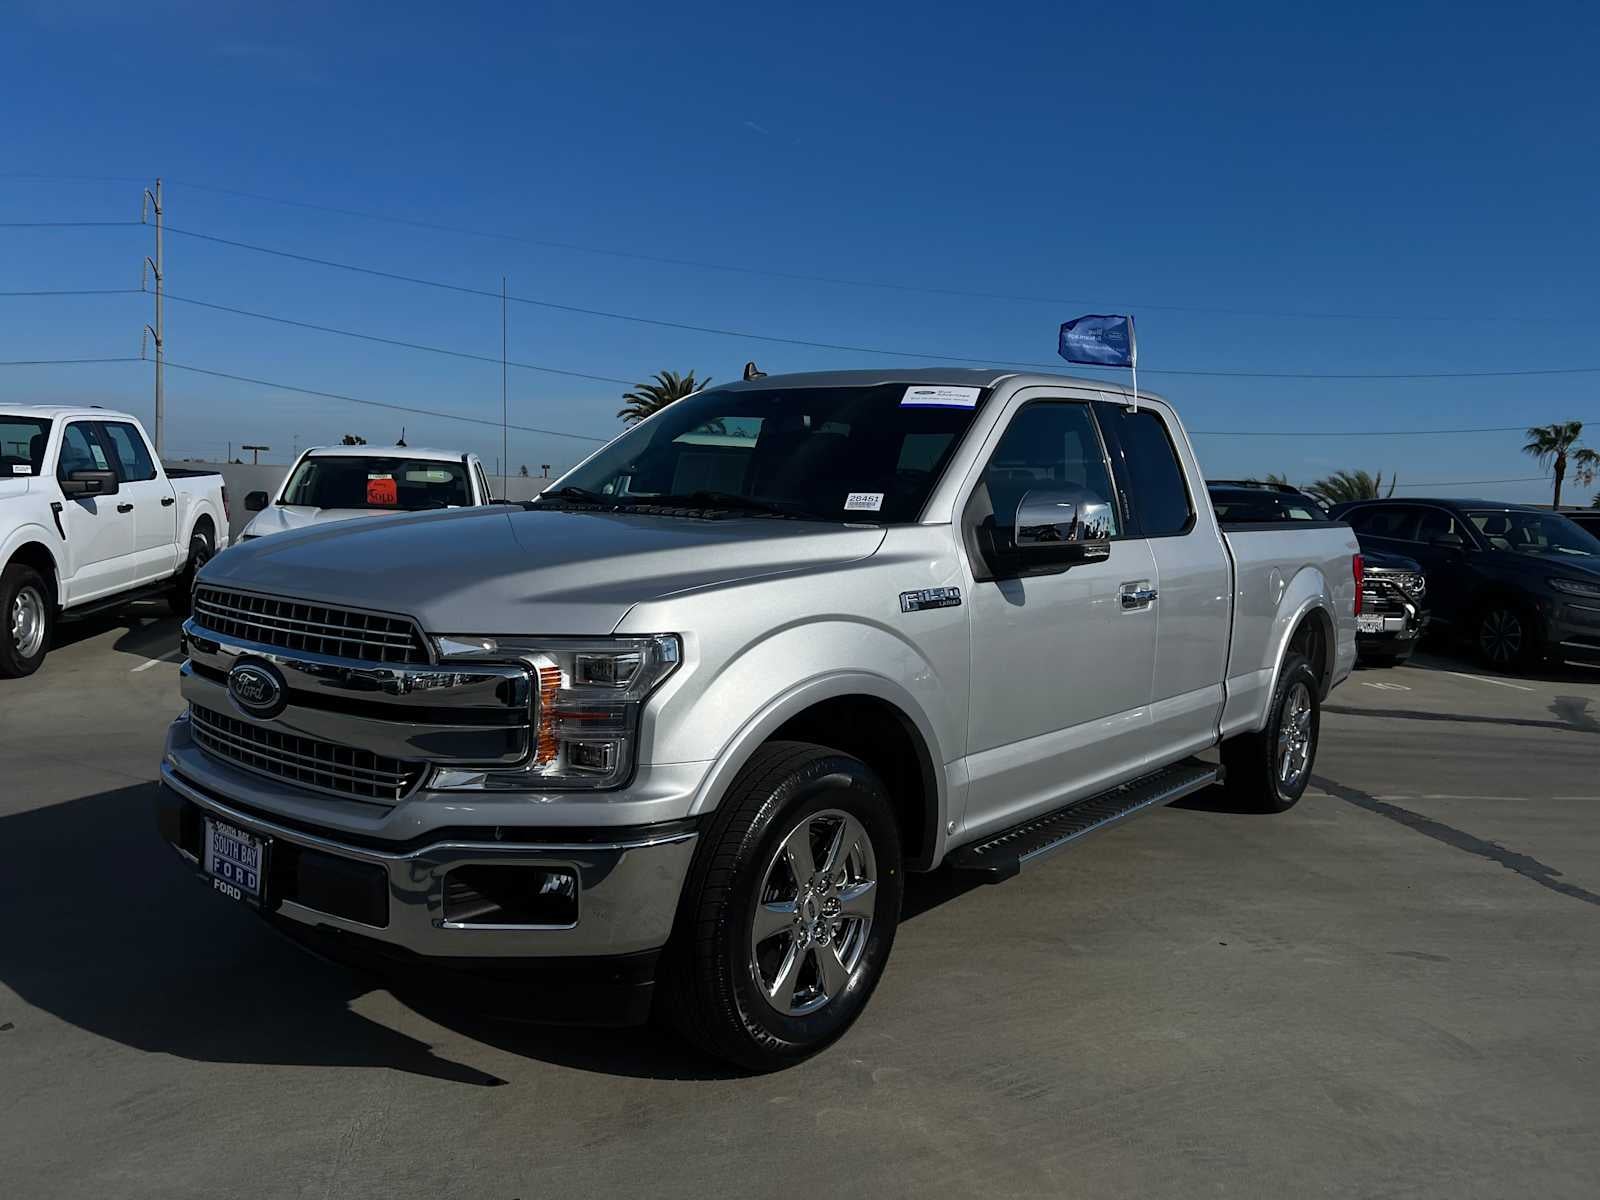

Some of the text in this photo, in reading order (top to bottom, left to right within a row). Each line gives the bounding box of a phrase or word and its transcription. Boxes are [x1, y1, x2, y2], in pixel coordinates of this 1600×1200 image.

[235, 672, 265, 700] Ford
[213, 833, 257, 867] SOUTH BAY
[213, 857, 256, 889] FORD
[213, 878, 241, 901] FORD
